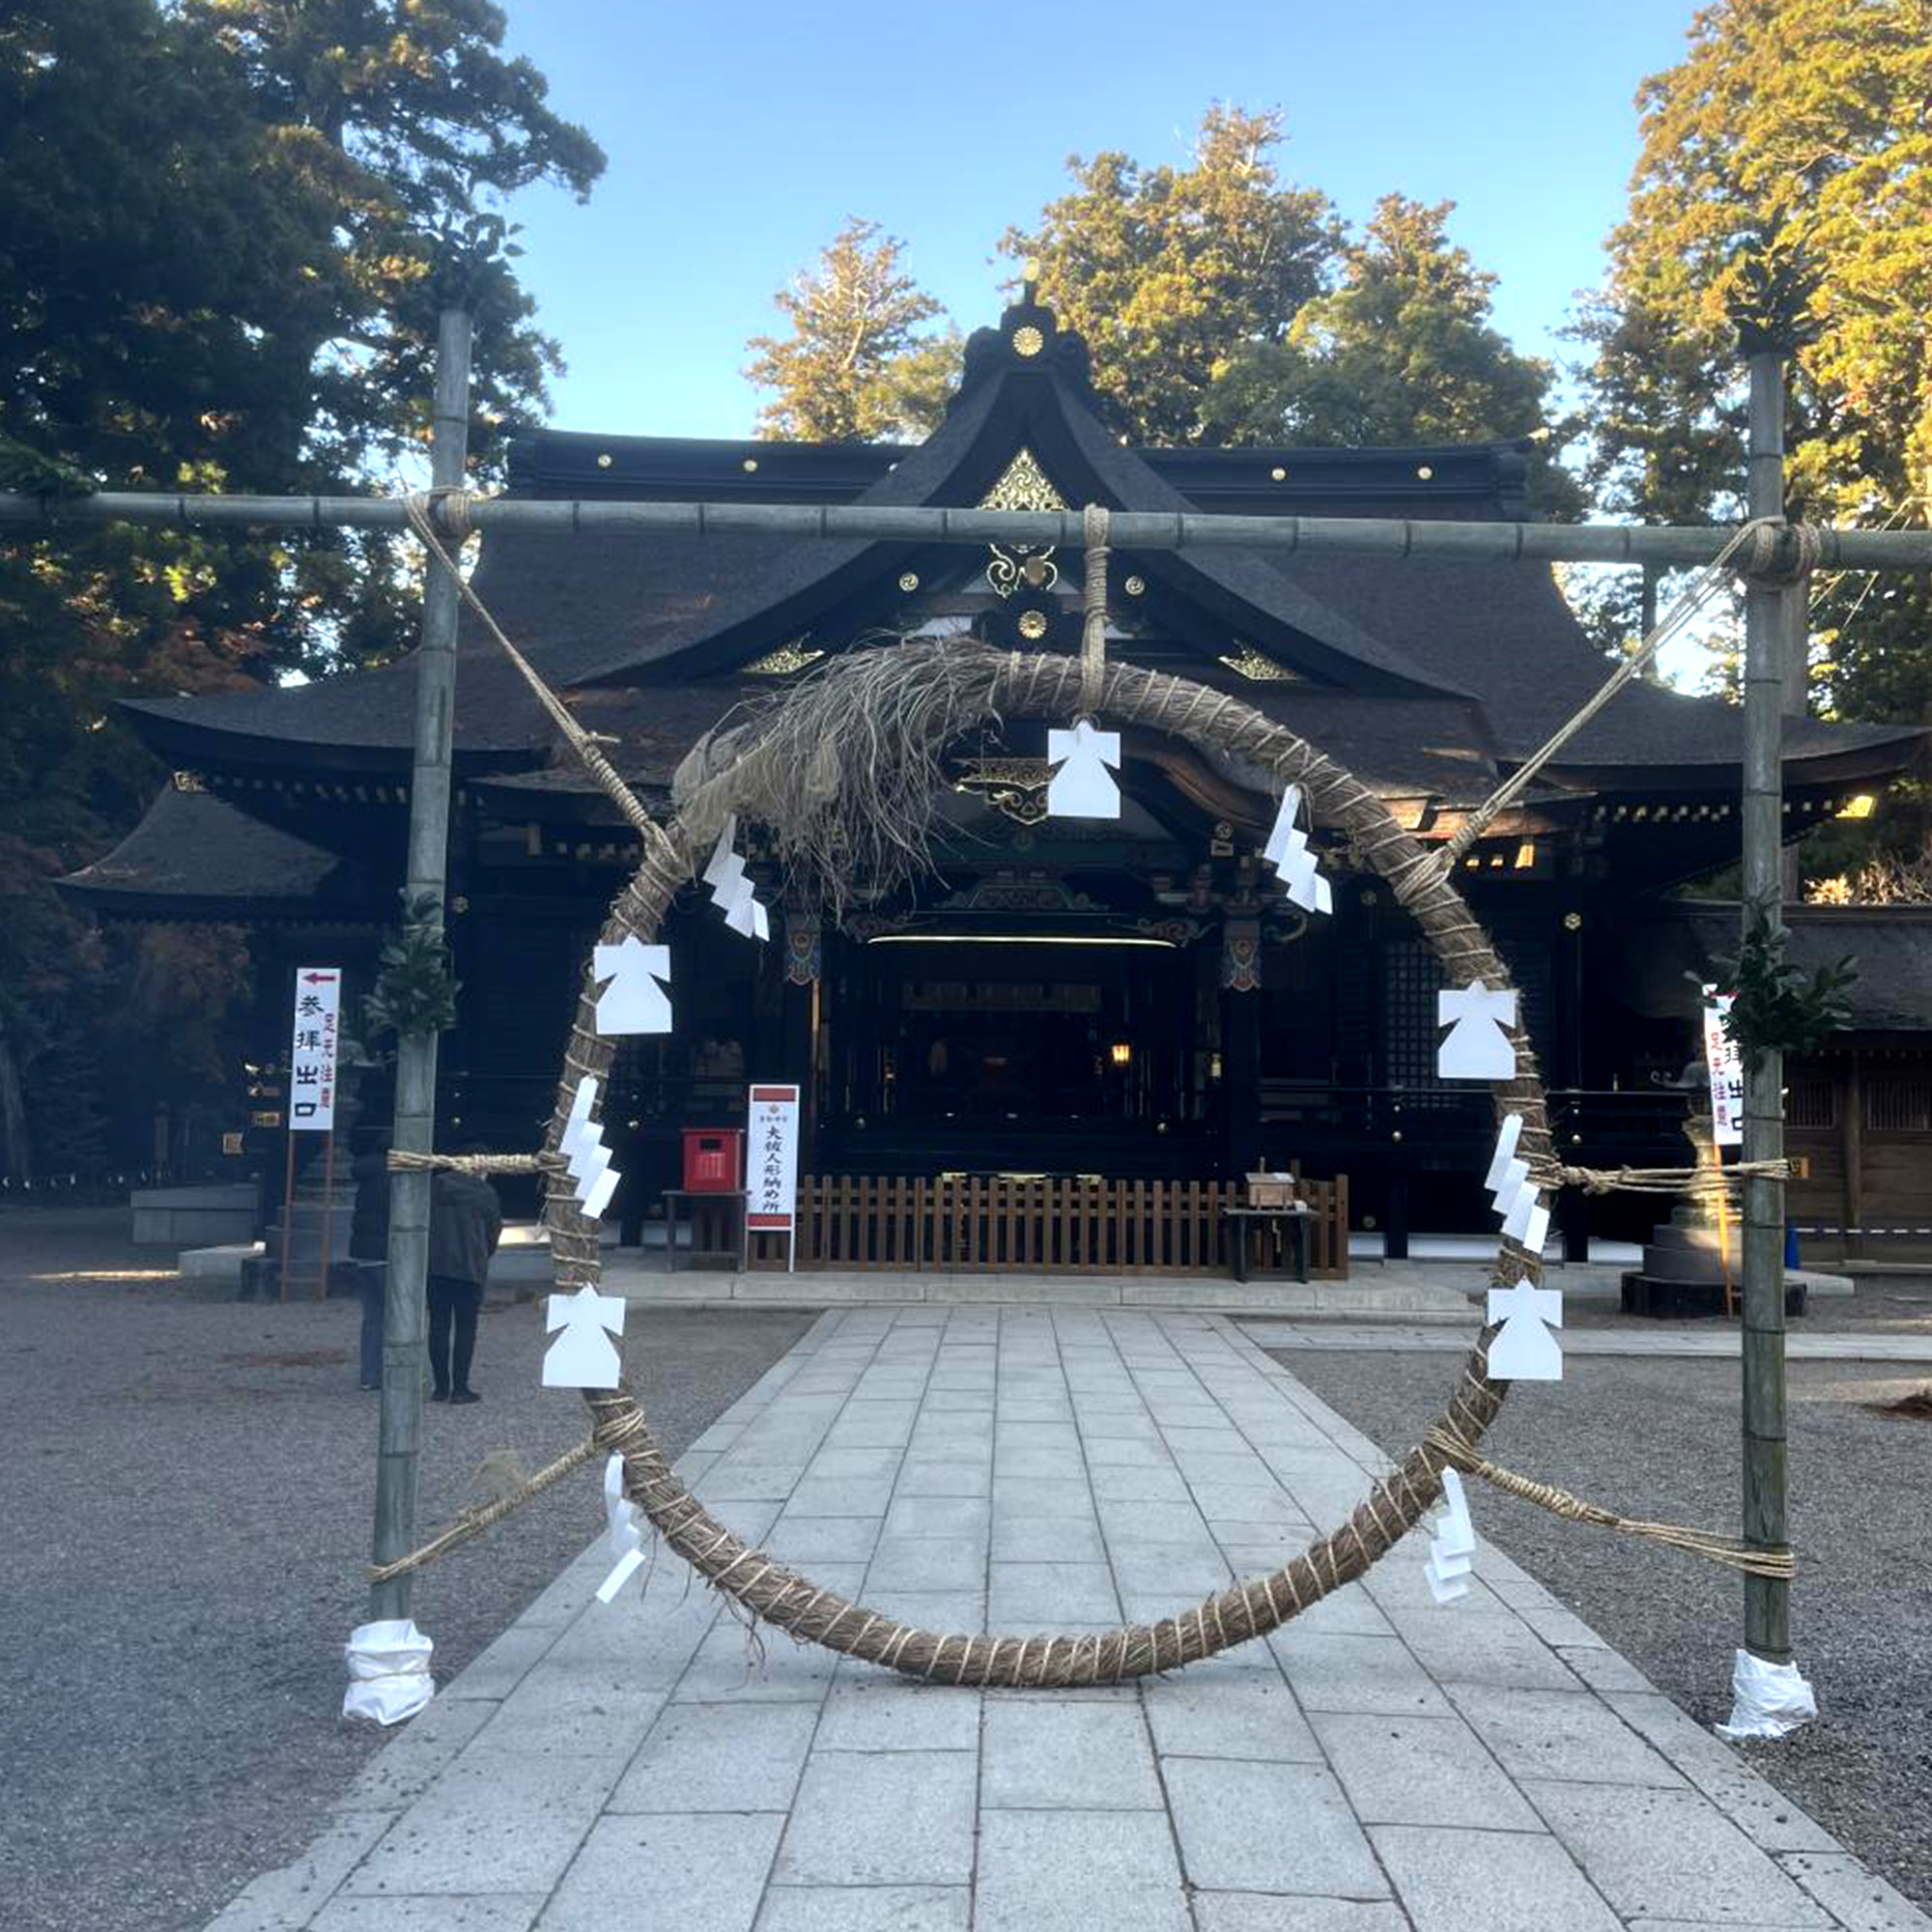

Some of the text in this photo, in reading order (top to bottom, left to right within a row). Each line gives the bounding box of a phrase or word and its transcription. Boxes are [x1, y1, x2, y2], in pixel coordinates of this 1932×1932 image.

[295, 995, 325, 1118] 参拝出口
[319, 1013, 336, 1109] 足元注意
[1710, 1031, 1728, 1127] 足元注意
